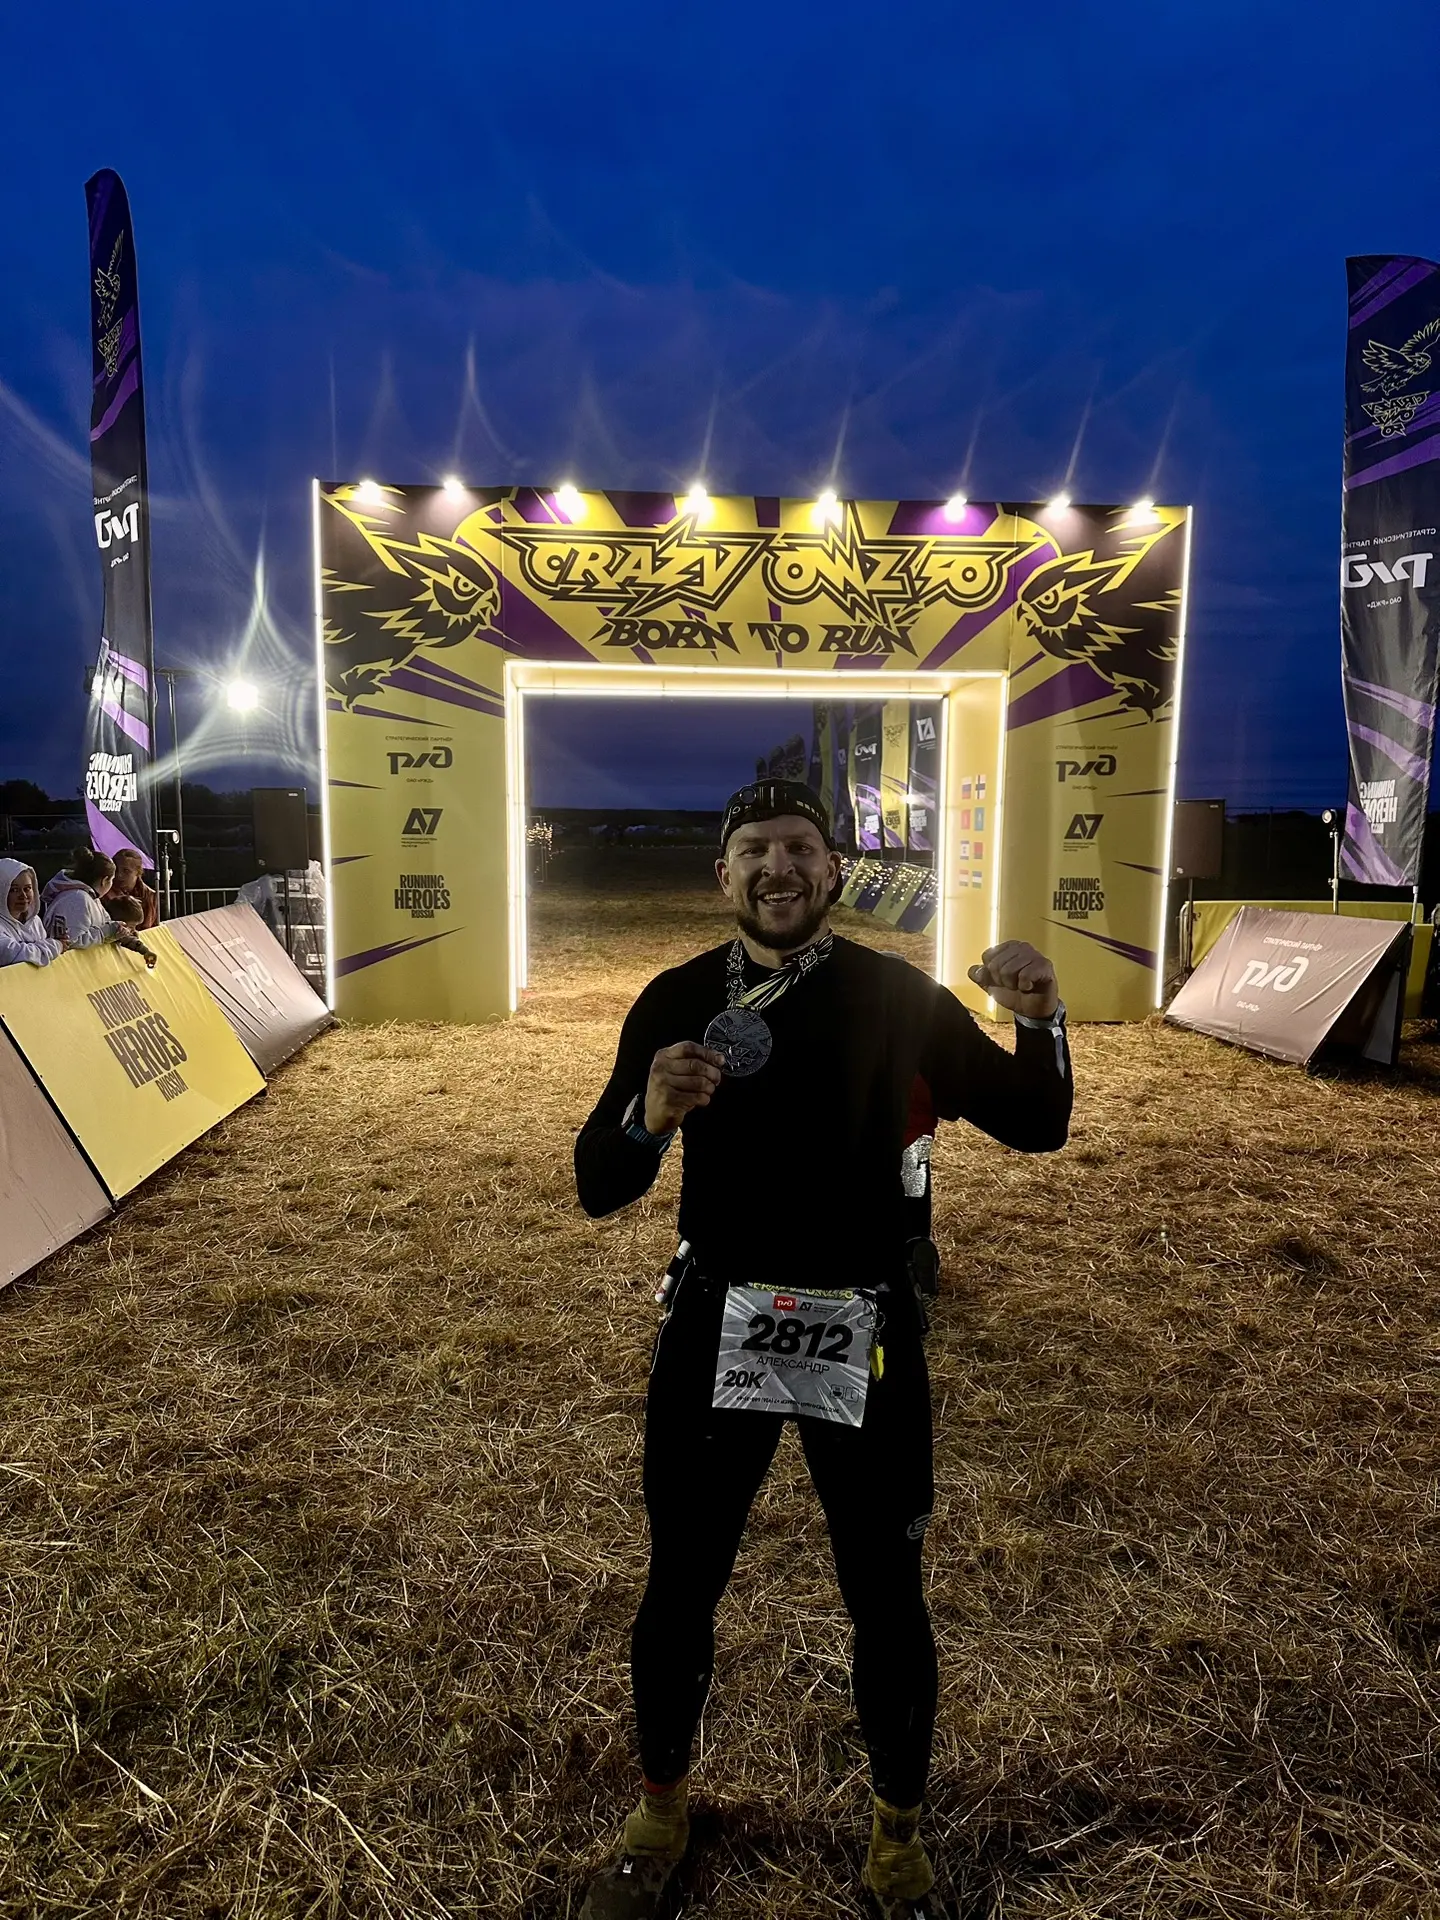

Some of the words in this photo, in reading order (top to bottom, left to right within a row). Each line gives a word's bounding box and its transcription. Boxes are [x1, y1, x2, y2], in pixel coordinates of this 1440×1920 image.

[519, 520, 765, 605] CRAZY
[588, 617, 740, 656] BORN
[747, 622, 809, 652] TO
[818, 625, 918, 657] RUN
[400, 874, 444, 889] RUNNING
[1059, 877, 1100, 891] RUNNING
[394, 889, 451, 910] HEROES
[1052, 891, 1105, 911] HEROES
[411, 909, 435, 919] RUSSIA
[1067, 911, 1088, 919] RUSSIA
[87, 979, 153, 1030] RUNNING
[103, 1012, 187, 1088] HEROES
[155, 1069, 189, 1102] RUSSIA
[741, 1313, 853, 1364] 2812
[756, 1355, 830, 1375] АЛЕКСАНДР
[722, 1369, 767, 1389] 20K
